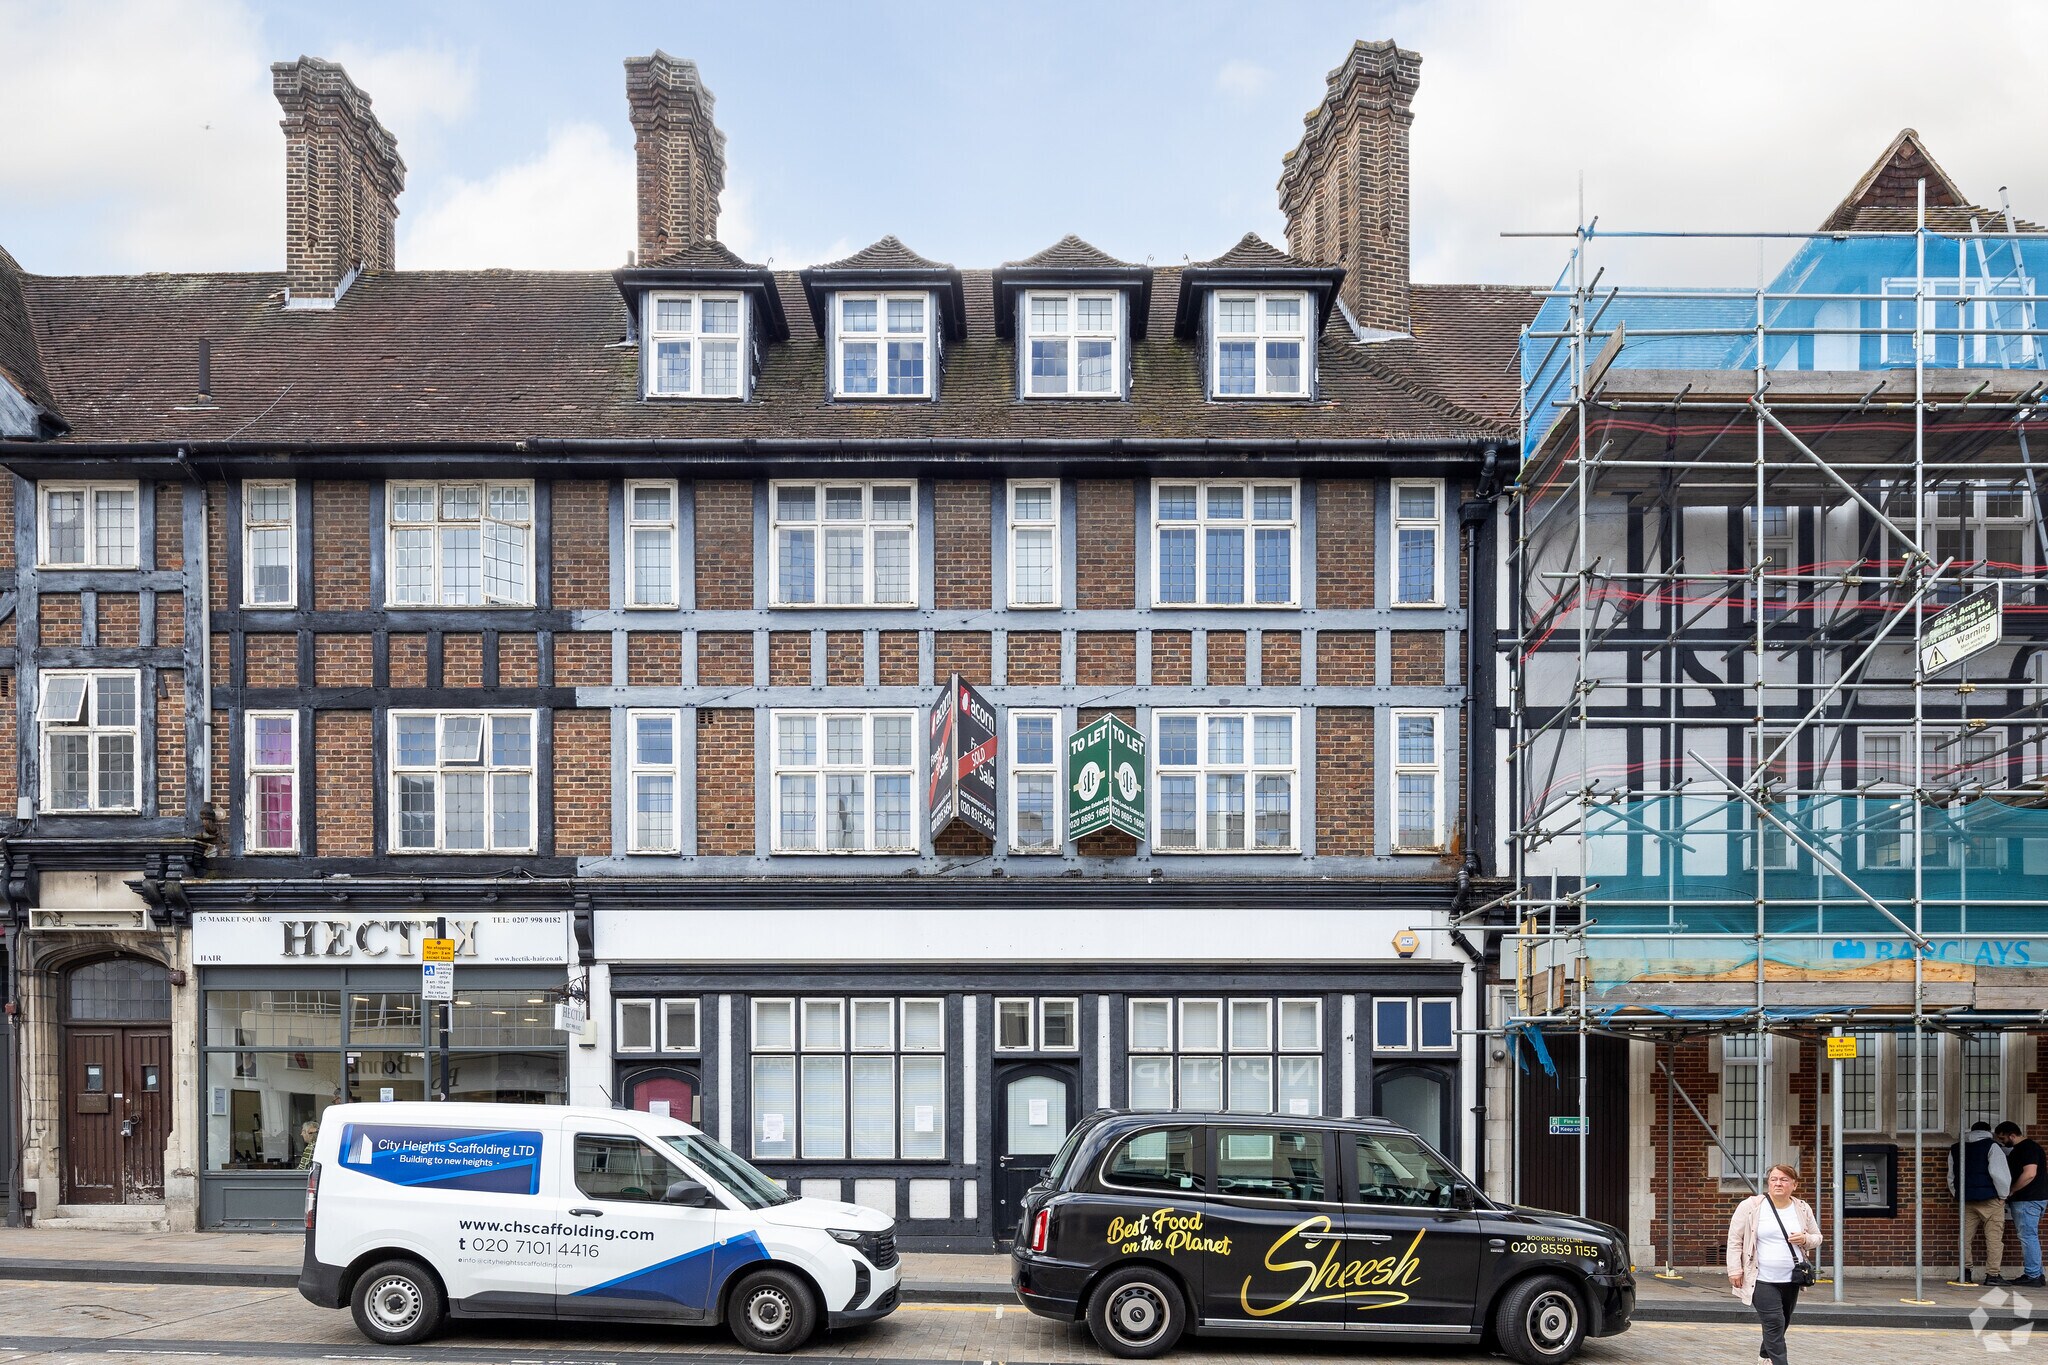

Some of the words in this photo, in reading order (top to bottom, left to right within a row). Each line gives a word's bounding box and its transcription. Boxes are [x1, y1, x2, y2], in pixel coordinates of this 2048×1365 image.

[1960, 598, 1985, 616] Access
[1978, 602, 1991, 615] Ltd
[1956, 622, 1991, 644] Warning
[970, 698, 994, 732] acorn
[1071, 737, 1085, 755] TO
[1088, 724, 1108, 747] LET
[1112, 724, 1125, 744] TO
[1127, 734, 1144, 755] LET
[972, 747, 986, 766] SOLD
[979, 764, 994, 789] Sale
[960, 800, 970, 815] 020
[378, 1139, 400, 1152] City
[403, 1142, 446, 1154] Heights
[448, 1142, 510, 1157] Scaffolding
[513, 1146, 535, 1156] LTD
[400, 1155, 433, 1166] Building
[462, 1157, 493, 1167] heights
[459, 1220, 654, 1240] www.chscaffolding.com
[1107, 1214, 1149, 1244] Best
[1152, 1207, 1203, 1232] Food
[459, 1238, 466, 1250] t
[472, 1238, 509, 1253] 020
[516, 1240, 551, 1255] 7101
[558, 1243, 599, 1258] 4416
[1122, 1242, 1140, 1254] on
[1141, 1234, 1162, 1251] the
[1165, 1231, 1232, 1256] Planet
[1511, 1242, 1537, 1253] 020
[1541, 1244, 1572, 1255] 8559
[1574, 1245, 1598, 1257] 1155
[1240, 1216, 1427, 1316] Sheesh
